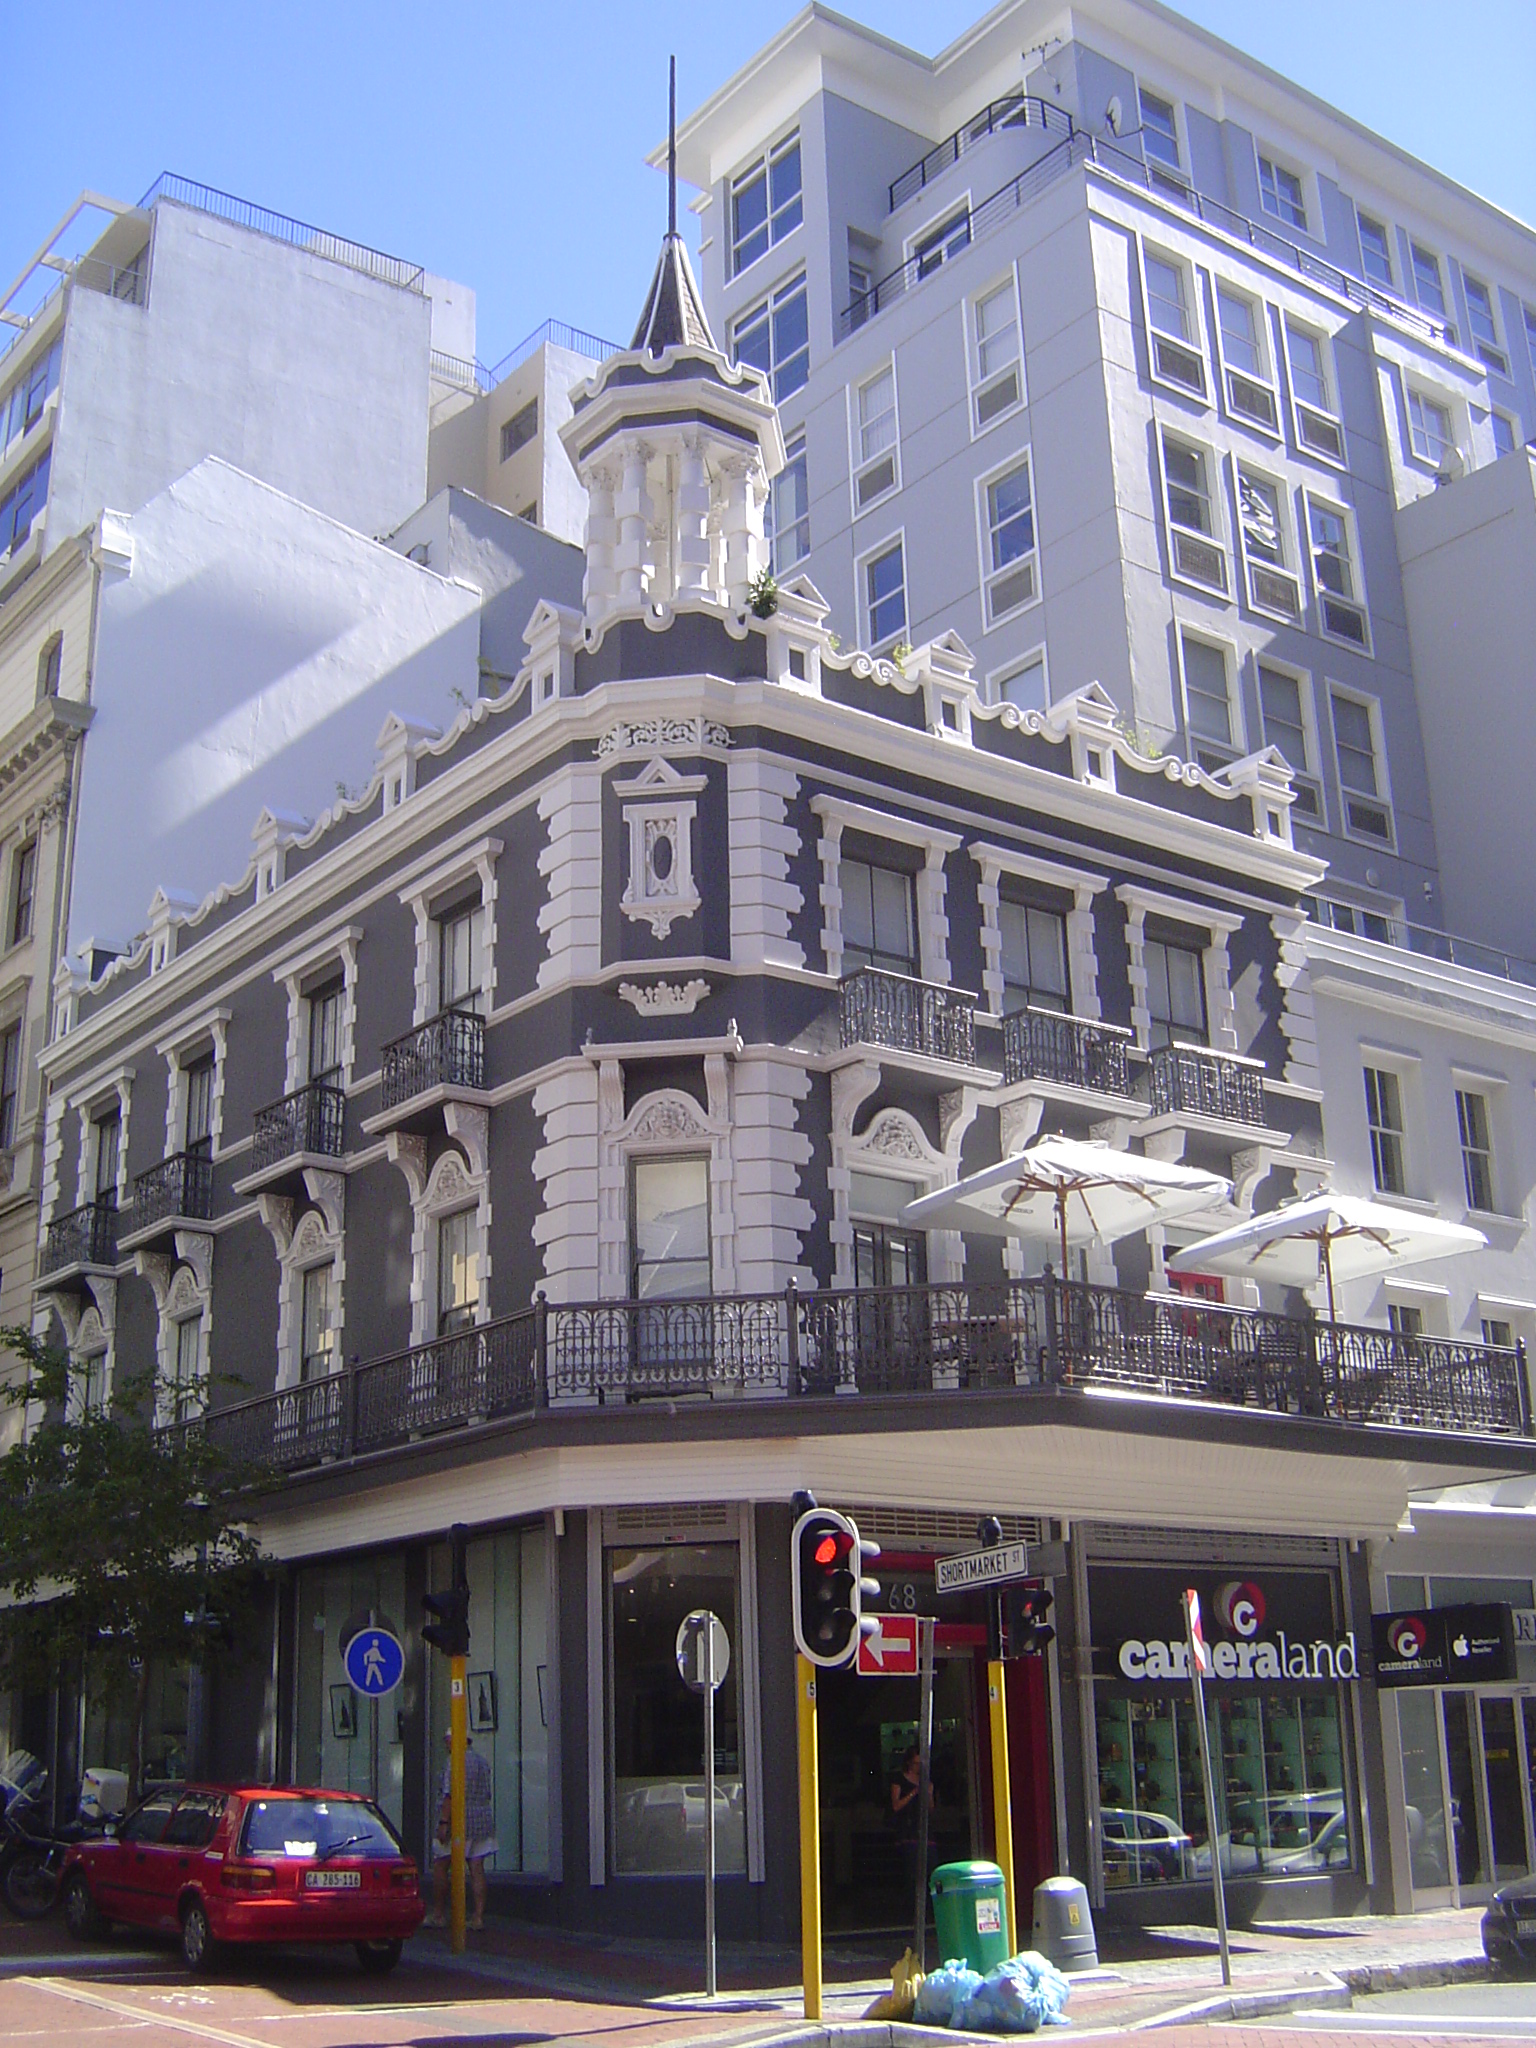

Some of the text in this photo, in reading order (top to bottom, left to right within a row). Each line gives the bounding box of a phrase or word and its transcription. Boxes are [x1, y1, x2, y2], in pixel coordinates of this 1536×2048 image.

[940, 1549, 1021, 1584] SHORTMARKET ST
[888, 1583, 916, 1610] 68
[1118, 1630, 1361, 1680] cameraland
[1378, 1656, 1442, 1672] cameraland
[305, 1872, 319, 1886] CA
